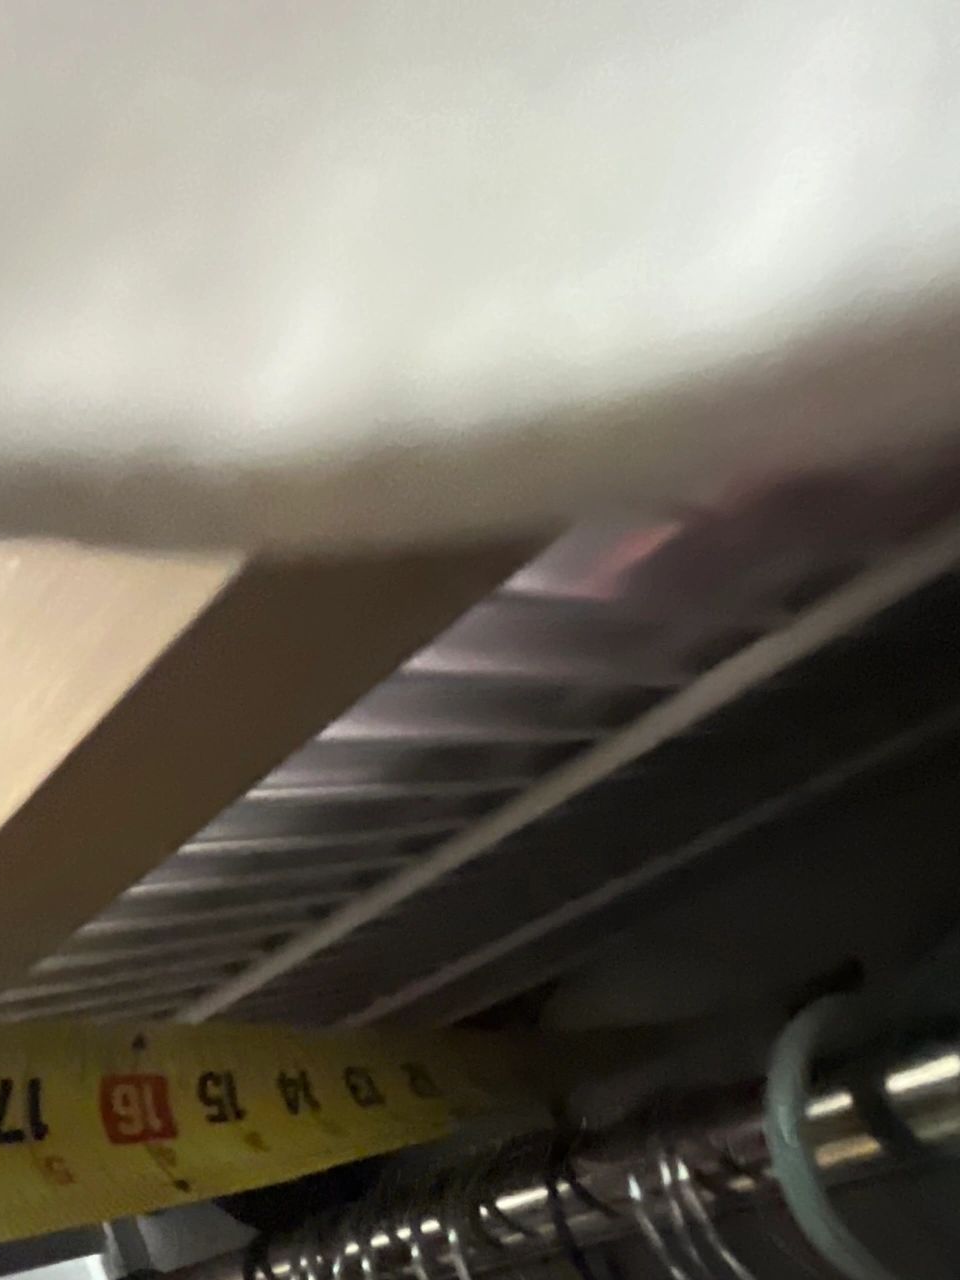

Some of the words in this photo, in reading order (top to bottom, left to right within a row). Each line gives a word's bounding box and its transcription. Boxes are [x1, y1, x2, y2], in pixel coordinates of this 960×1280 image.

[110, 1082, 163, 1137] 16
[197, 1071, 246, 1123] 15
[277, 1069, 321, 1114] 14
